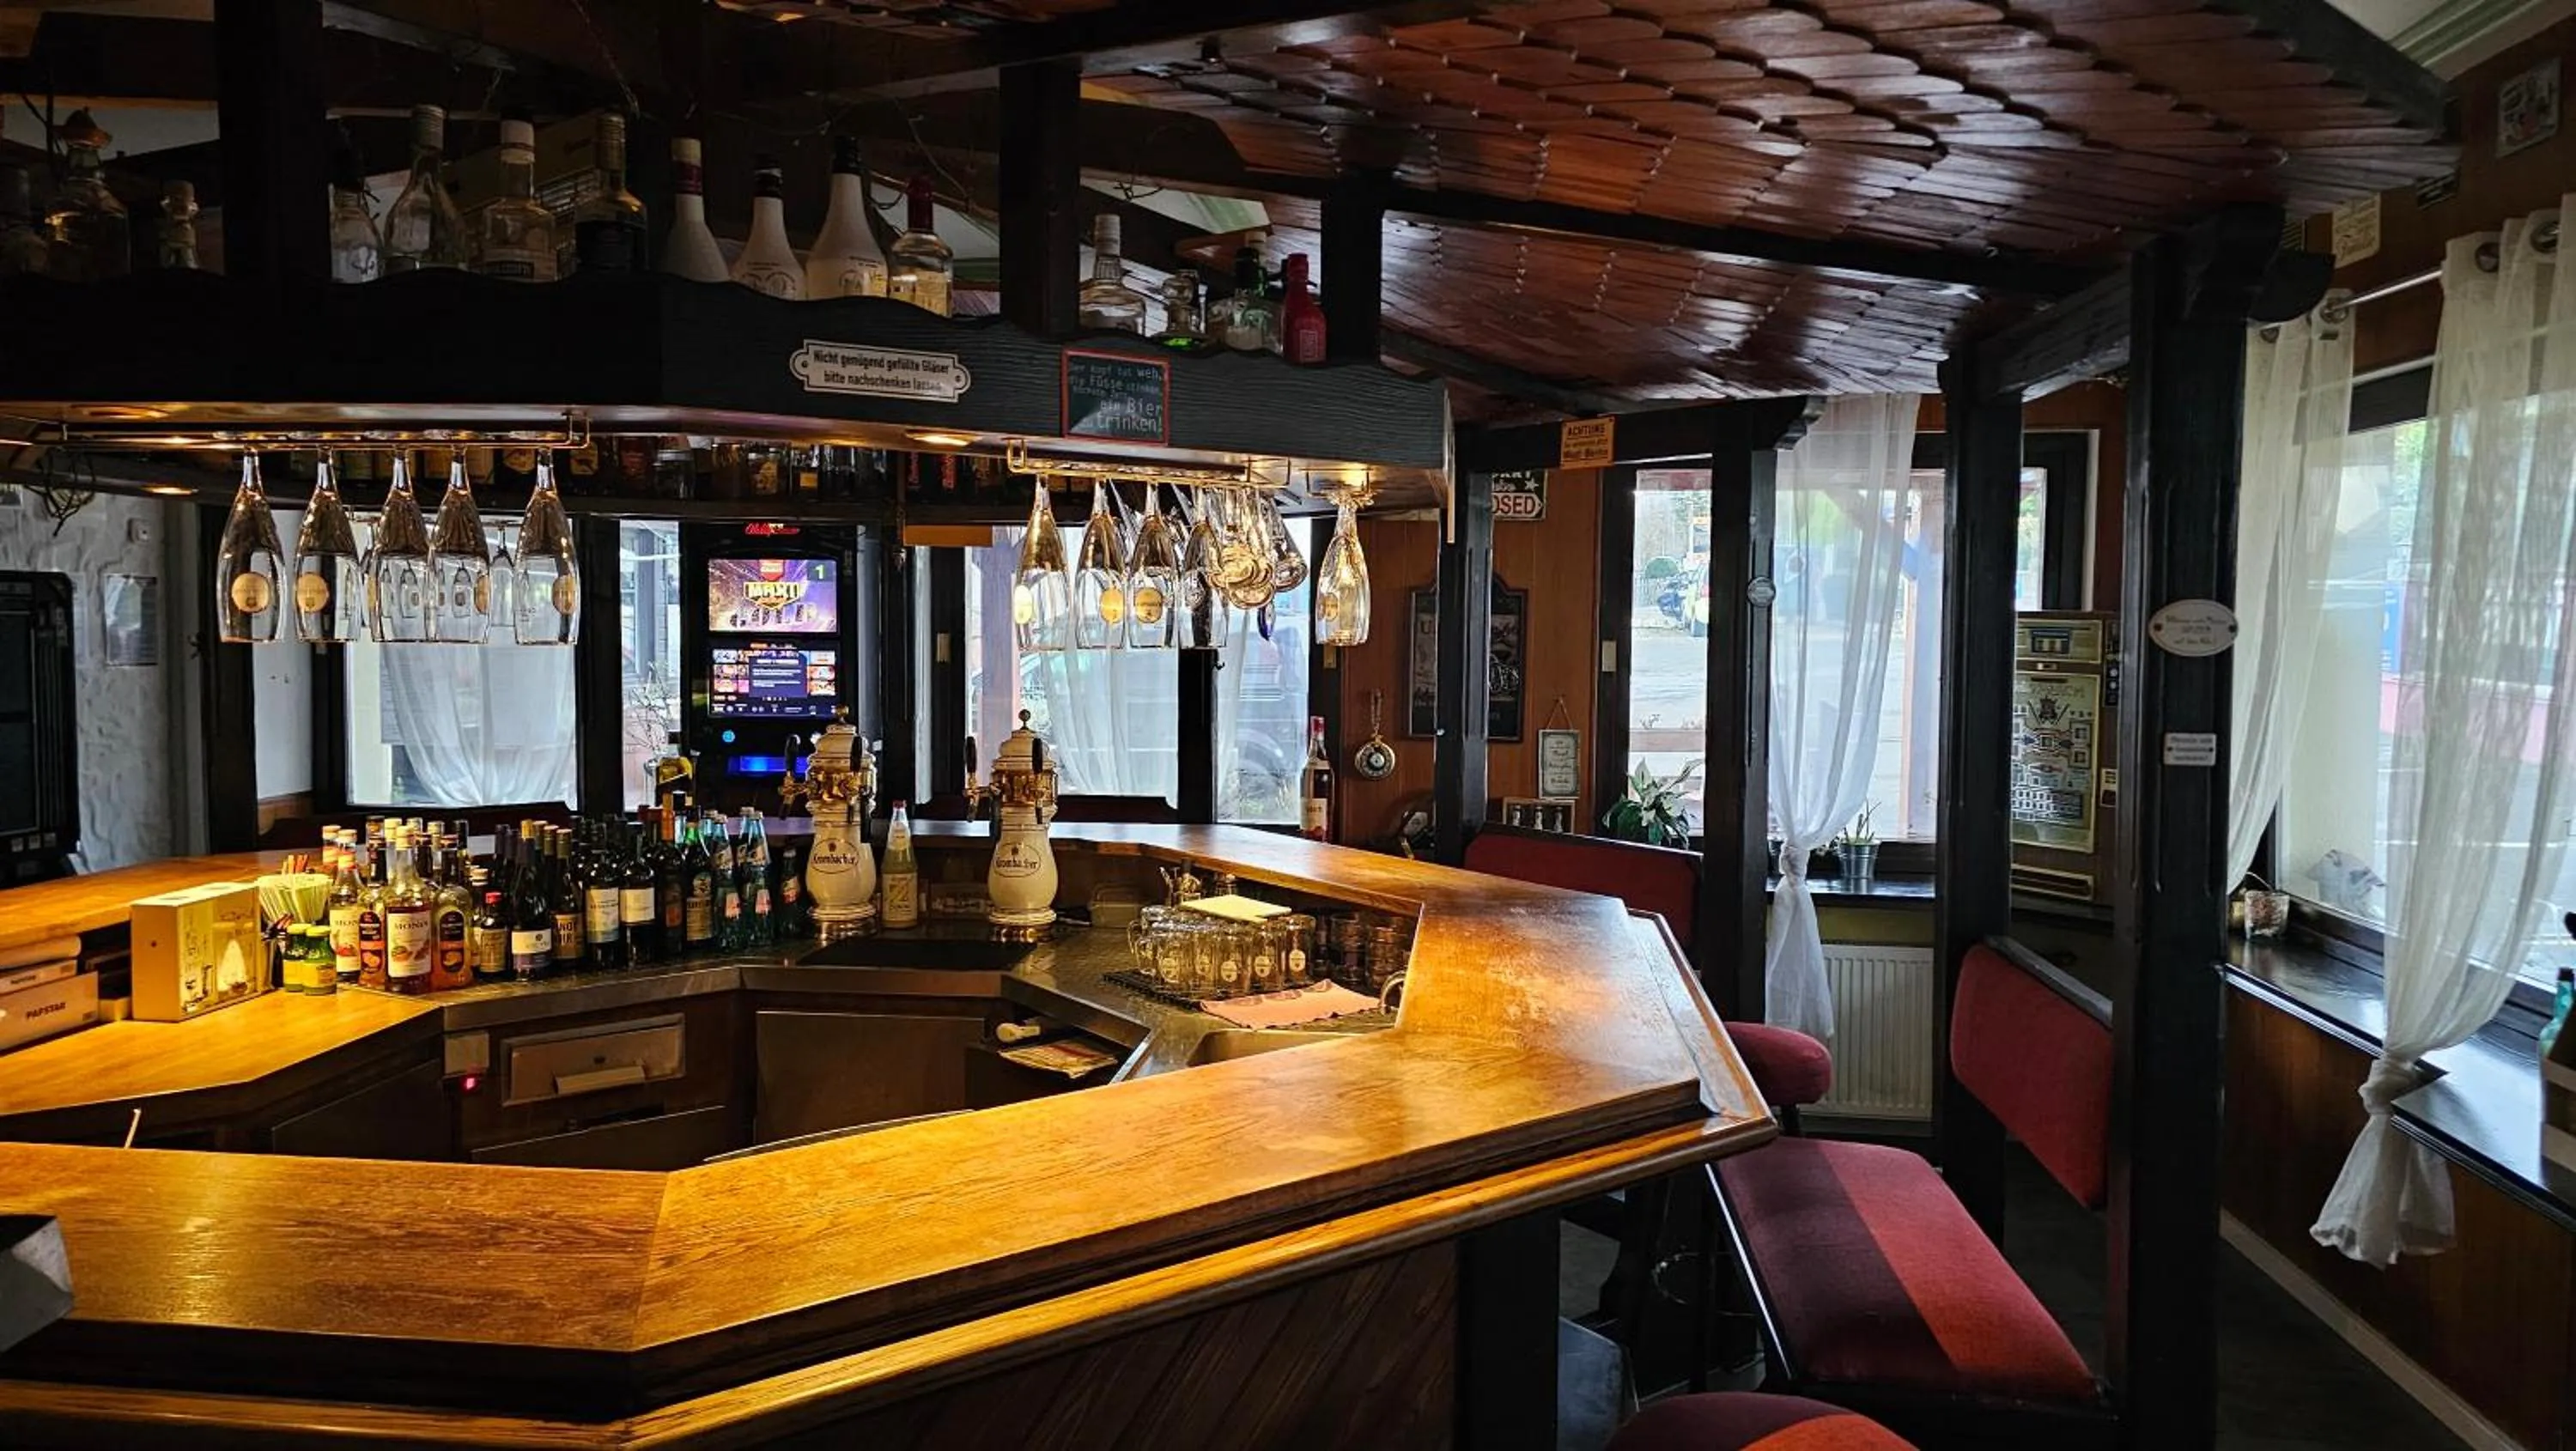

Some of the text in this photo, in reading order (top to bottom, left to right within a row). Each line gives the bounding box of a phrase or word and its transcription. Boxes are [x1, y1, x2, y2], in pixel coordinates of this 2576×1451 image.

[813, 349, 839, 364] Nicht
[841, 353, 884, 369] genügend
[887, 357, 920, 373] gefüllte
[823, 370, 846, 384] bitte
[848, 372, 911, 388] nachschenken
[1127, 396, 1163, 417] Bier
[1492, 495, 1536, 514] OSED
[814, 564, 825, 580] 1
